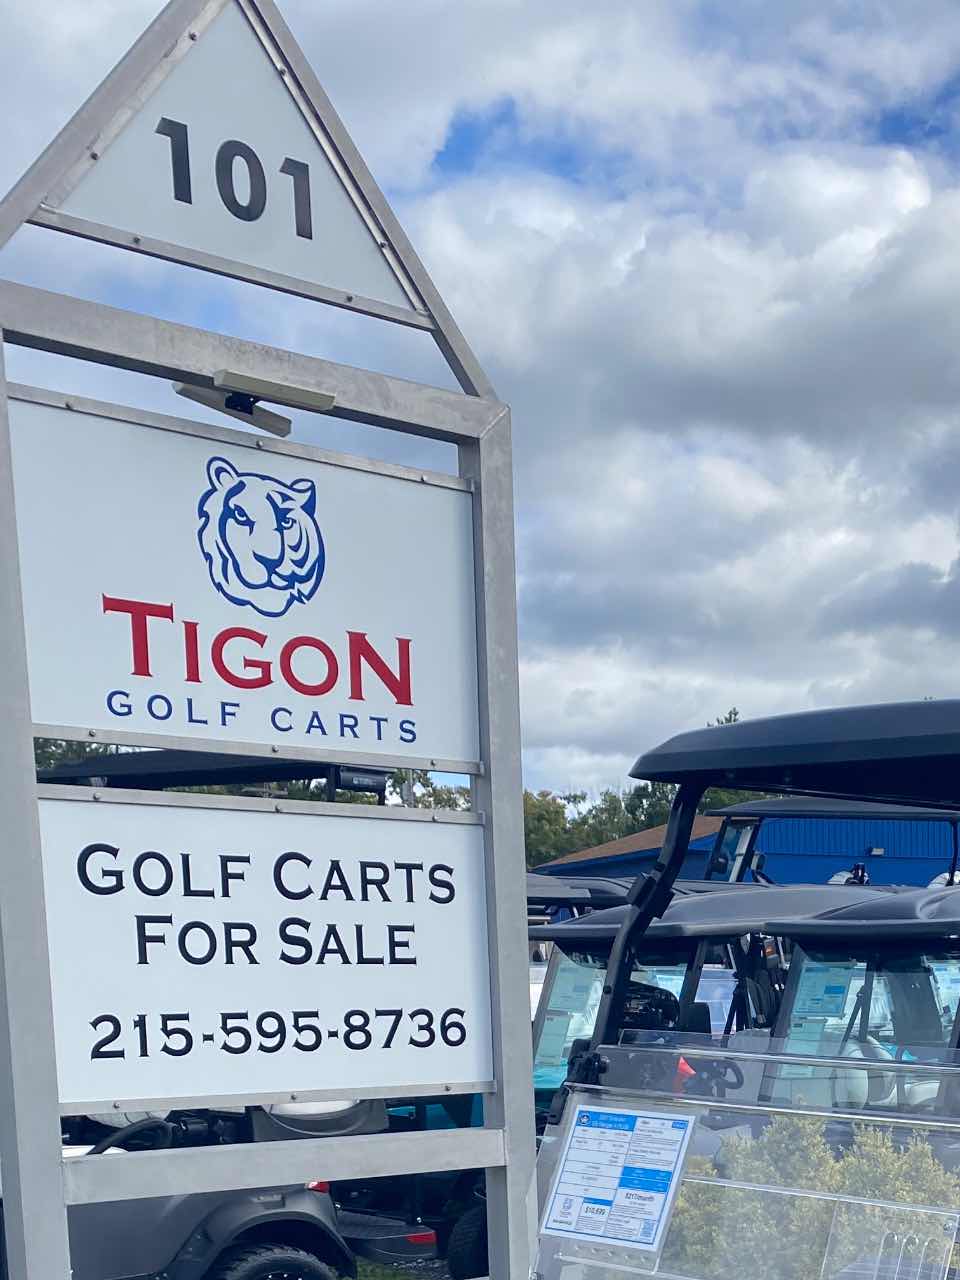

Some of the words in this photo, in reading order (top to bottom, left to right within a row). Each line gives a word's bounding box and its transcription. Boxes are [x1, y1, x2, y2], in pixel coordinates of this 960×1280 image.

[155, 116, 313, 240] 101
[102, 592, 414, 706] TIGON
[106, 689, 242, 727] GOLF
[270, 706, 418, 744] CARTS
[76, 843, 251, 899] GOLF
[273, 851, 457, 905] CARTS
[135, 914, 260, 966] FOR
[278, 917, 418, 966] SALE
[89, 1007, 468, 1062] 215-595-8736
